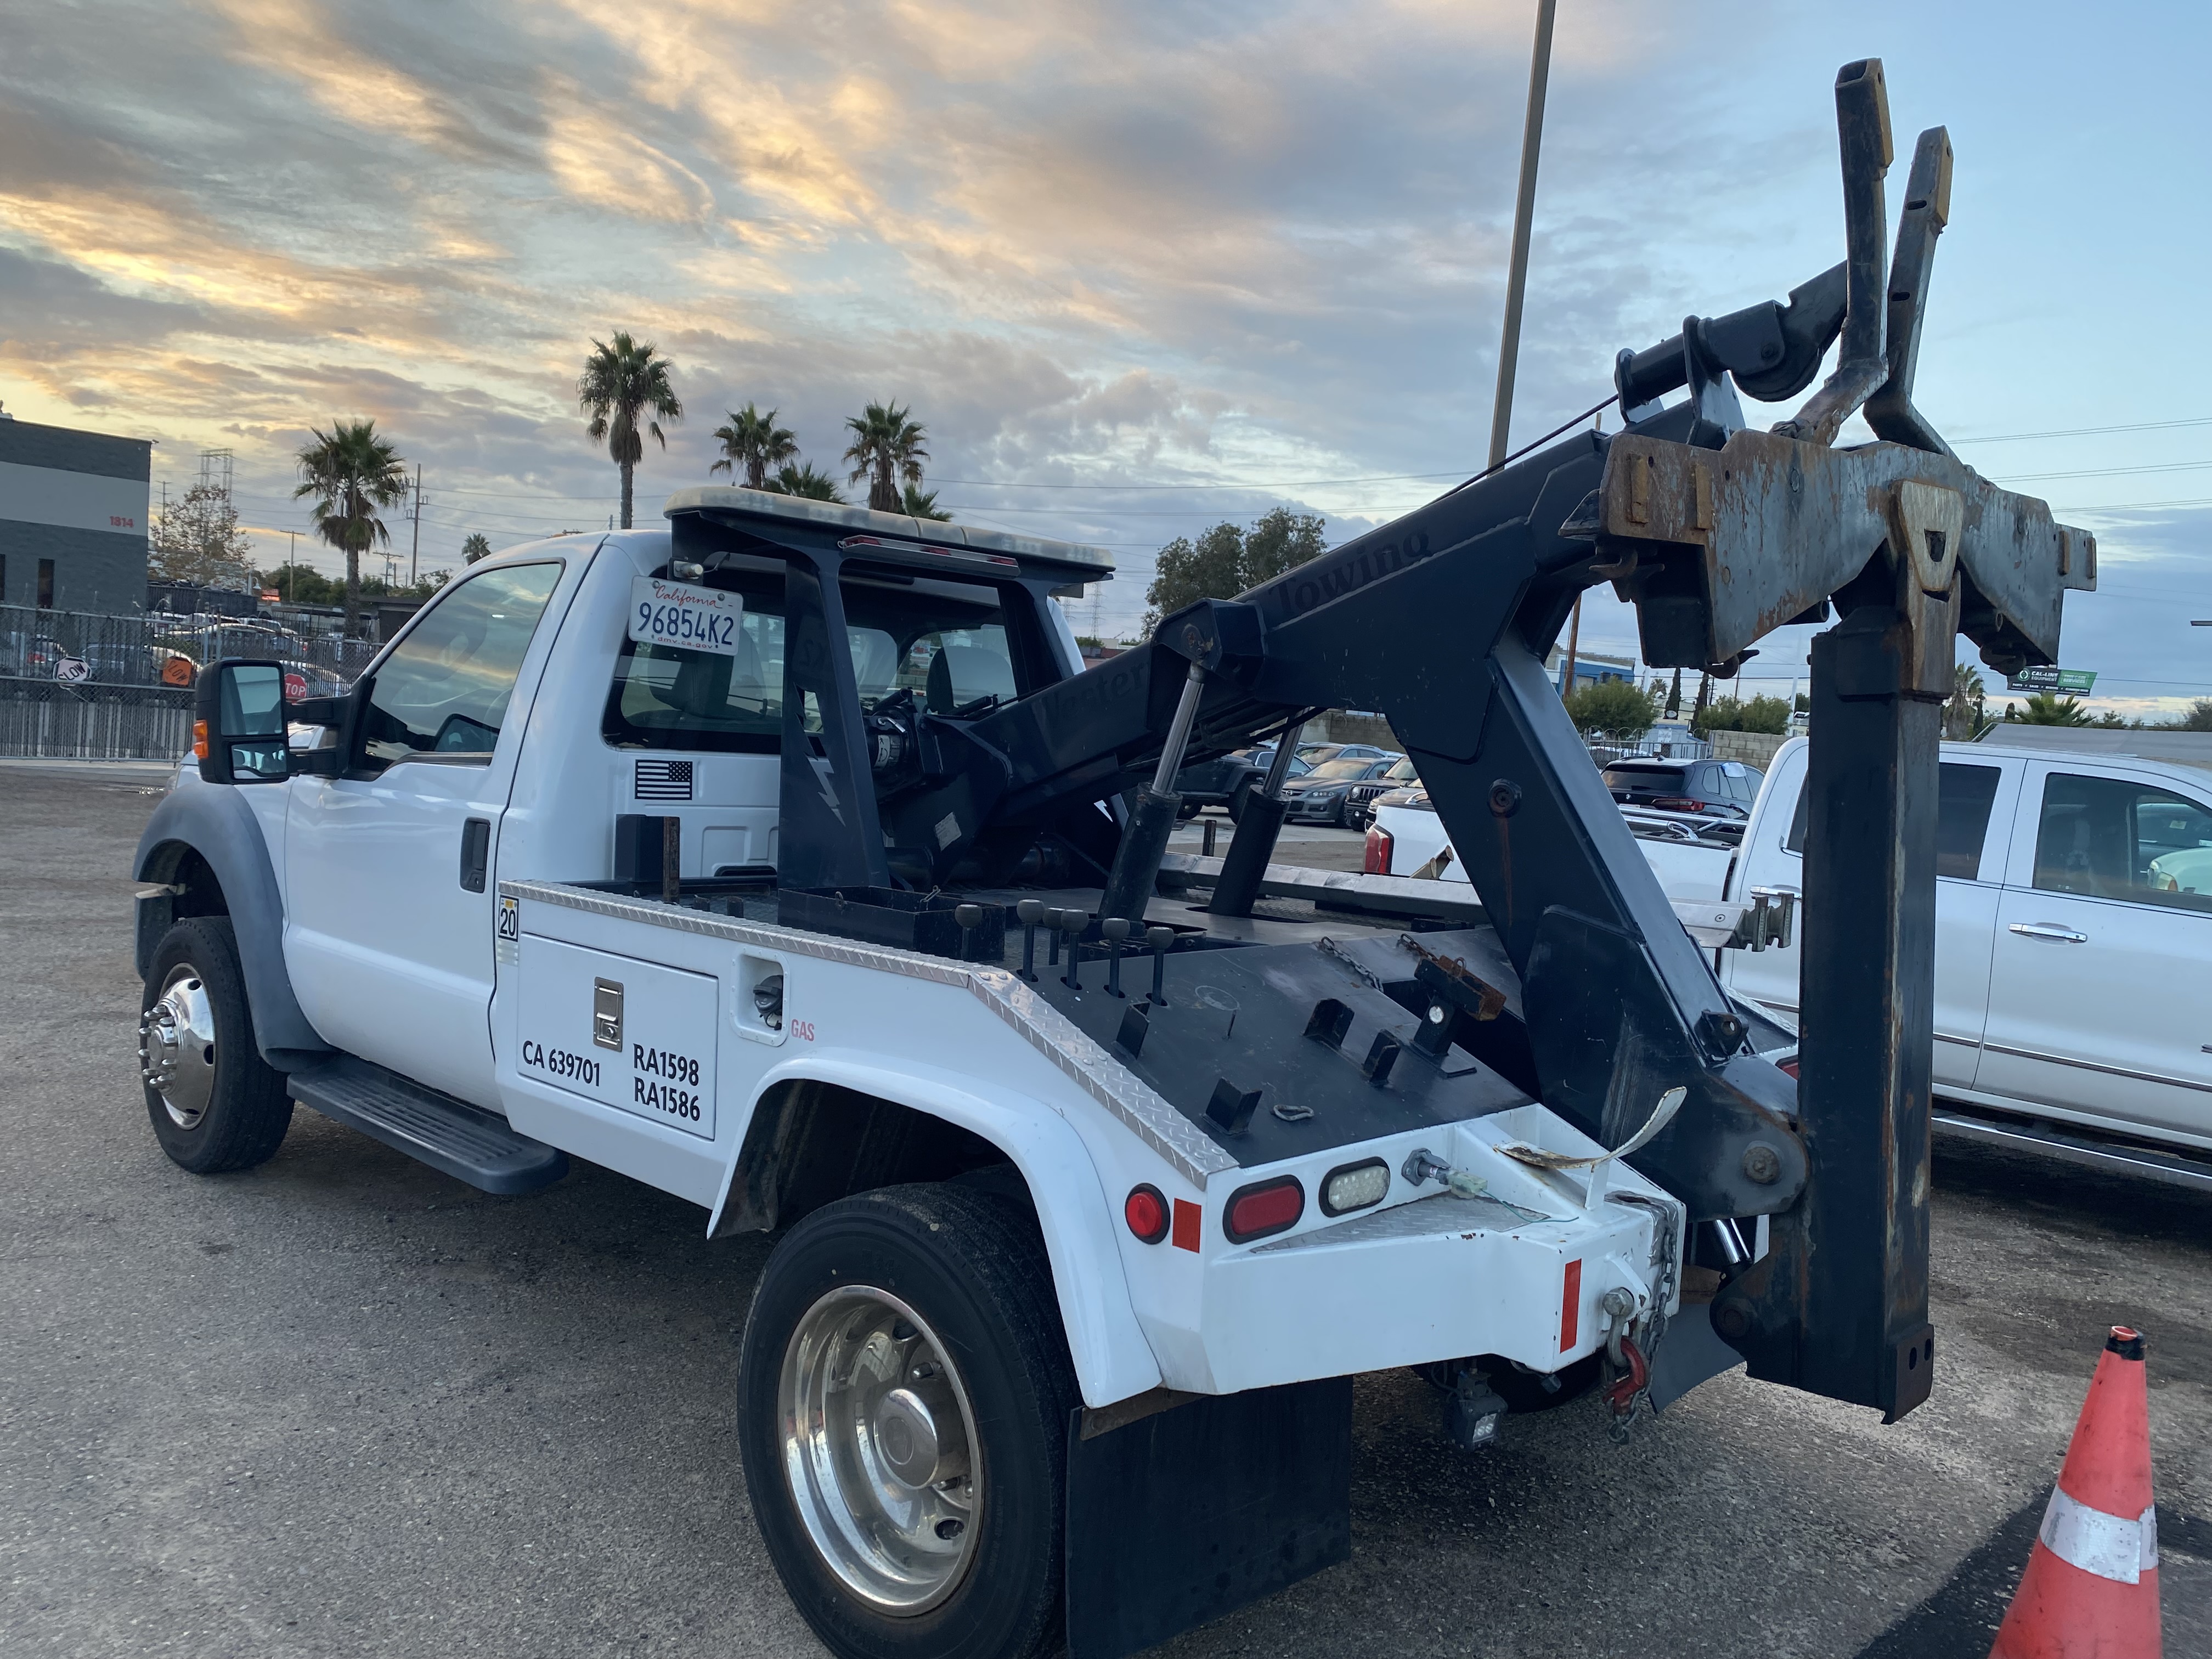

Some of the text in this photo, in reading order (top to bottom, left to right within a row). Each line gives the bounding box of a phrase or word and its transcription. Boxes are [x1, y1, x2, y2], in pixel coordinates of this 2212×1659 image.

[110, 516, 134, 528] 1814
[655, 585, 723, 609] California
[637, 602, 734, 646] 96854K2
[657, 636, 713, 649] dmv.ca.gov
[58, 662, 86, 681] SLOW
[167, 659, 188, 681] SLOW
[285, 683, 306, 696] TOP
[500, 907, 516, 936] 20
[791, 1018, 815, 1042] GAS
[522, 1040, 600, 1087] CA 639701
[633, 1043, 699, 1087] RA1598
[633, 1076, 701, 1122] RA1586
